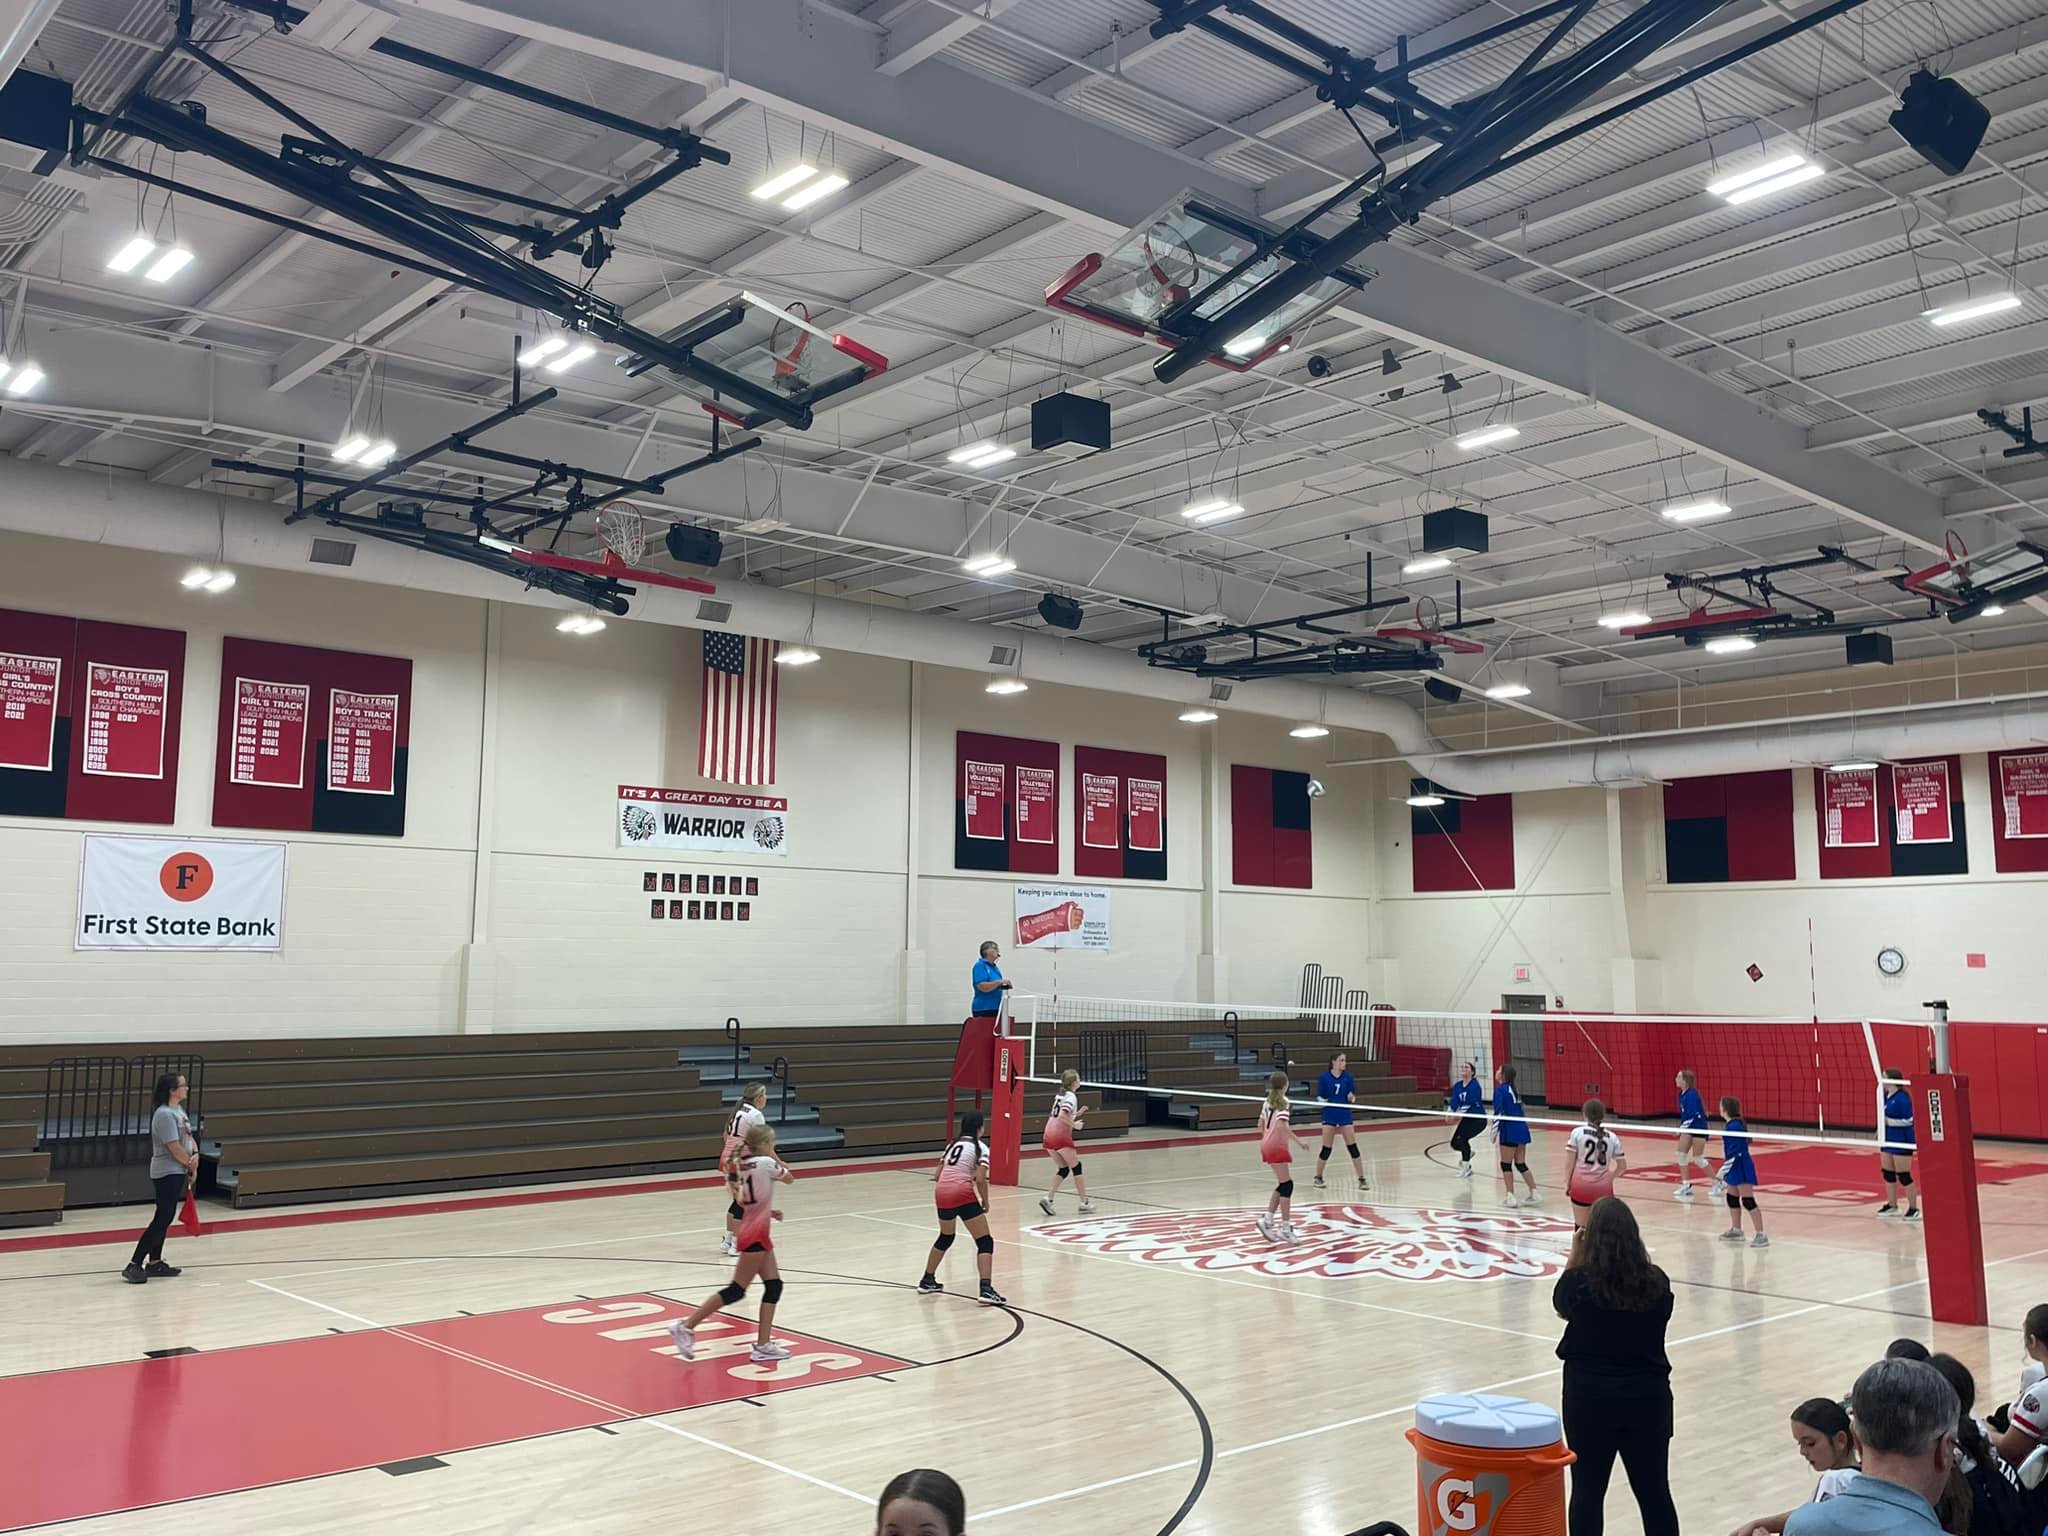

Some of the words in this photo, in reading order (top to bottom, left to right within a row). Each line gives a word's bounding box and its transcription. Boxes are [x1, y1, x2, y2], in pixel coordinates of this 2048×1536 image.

[0, 656, 56, 670] EASTERN
[2, 672, 30, 682] GIRL'S
[112, 670, 164, 682] EASTERN
[11, 681, 54, 692] COUNTRY
[114, 685, 140, 694] BOY'S
[258, 685, 304, 697] EASTERN
[91, 690, 120, 698] CROSS
[122, 693, 163, 703] COUNTRY
[350, 696, 394, 706] EASTERN
[241, 697, 270, 707] GIRL'S
[273, 700, 303, 711] TRACK
[335, 707, 361, 717] BOY'S
[363, 710, 392, 720] TRACK
[622, 788, 647, 798] IT'S
[650, 790, 661, 800] A
[664, 791, 705, 804] GREAT
[708, 794, 732, 806] DAY
[736, 796, 752, 806] TO
[755, 798, 772, 808] BE
[774, 800, 783, 809] A
[664, 812, 746, 840] WARRIOR
[176, 864, 199, 890] F
[645, 876, 756, 894] WARRIOR
[1018, 888, 1041, 898] Keeping
[1042, 890, 1052, 898] you
[1052, 888, 1069, 898] active
[1090, 890, 1107, 898] home.
[653, 904, 748, 920] NATION
[84, 914, 138, 935] First
[145, 915, 211, 936] State
[216, 916, 276, 937] Bank
[1334, 1083, 1341, 1095] 7
[1438, 1478, 1477, 1531] G
